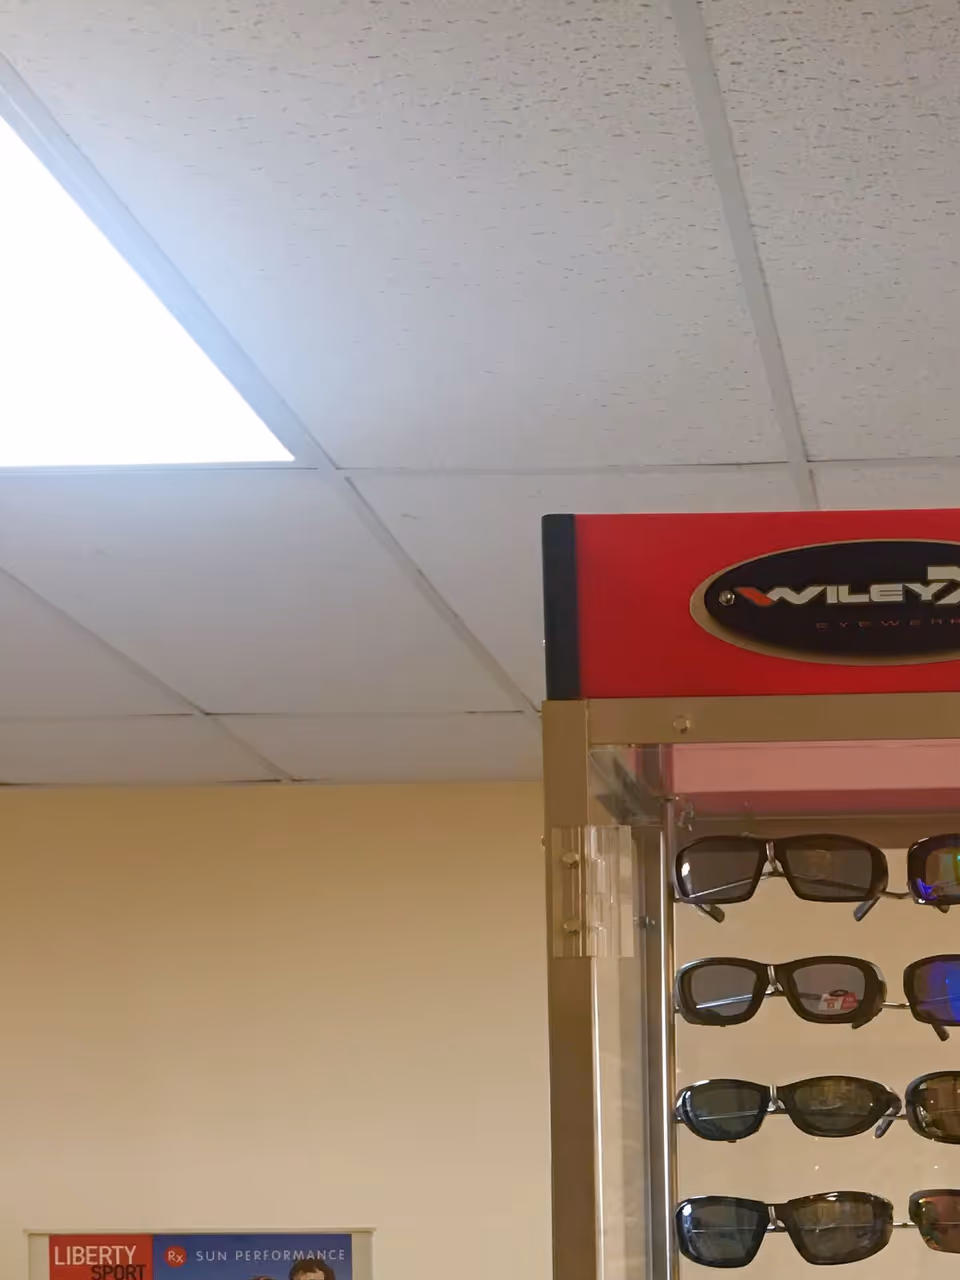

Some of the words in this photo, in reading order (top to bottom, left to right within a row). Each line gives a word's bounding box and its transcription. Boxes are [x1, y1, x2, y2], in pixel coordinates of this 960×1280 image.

[54, 1245, 137, 1266] LIBERTY
[195, 1250, 228, 1262] SUN
[234, 1249, 346, 1262] PERFORMANCE
